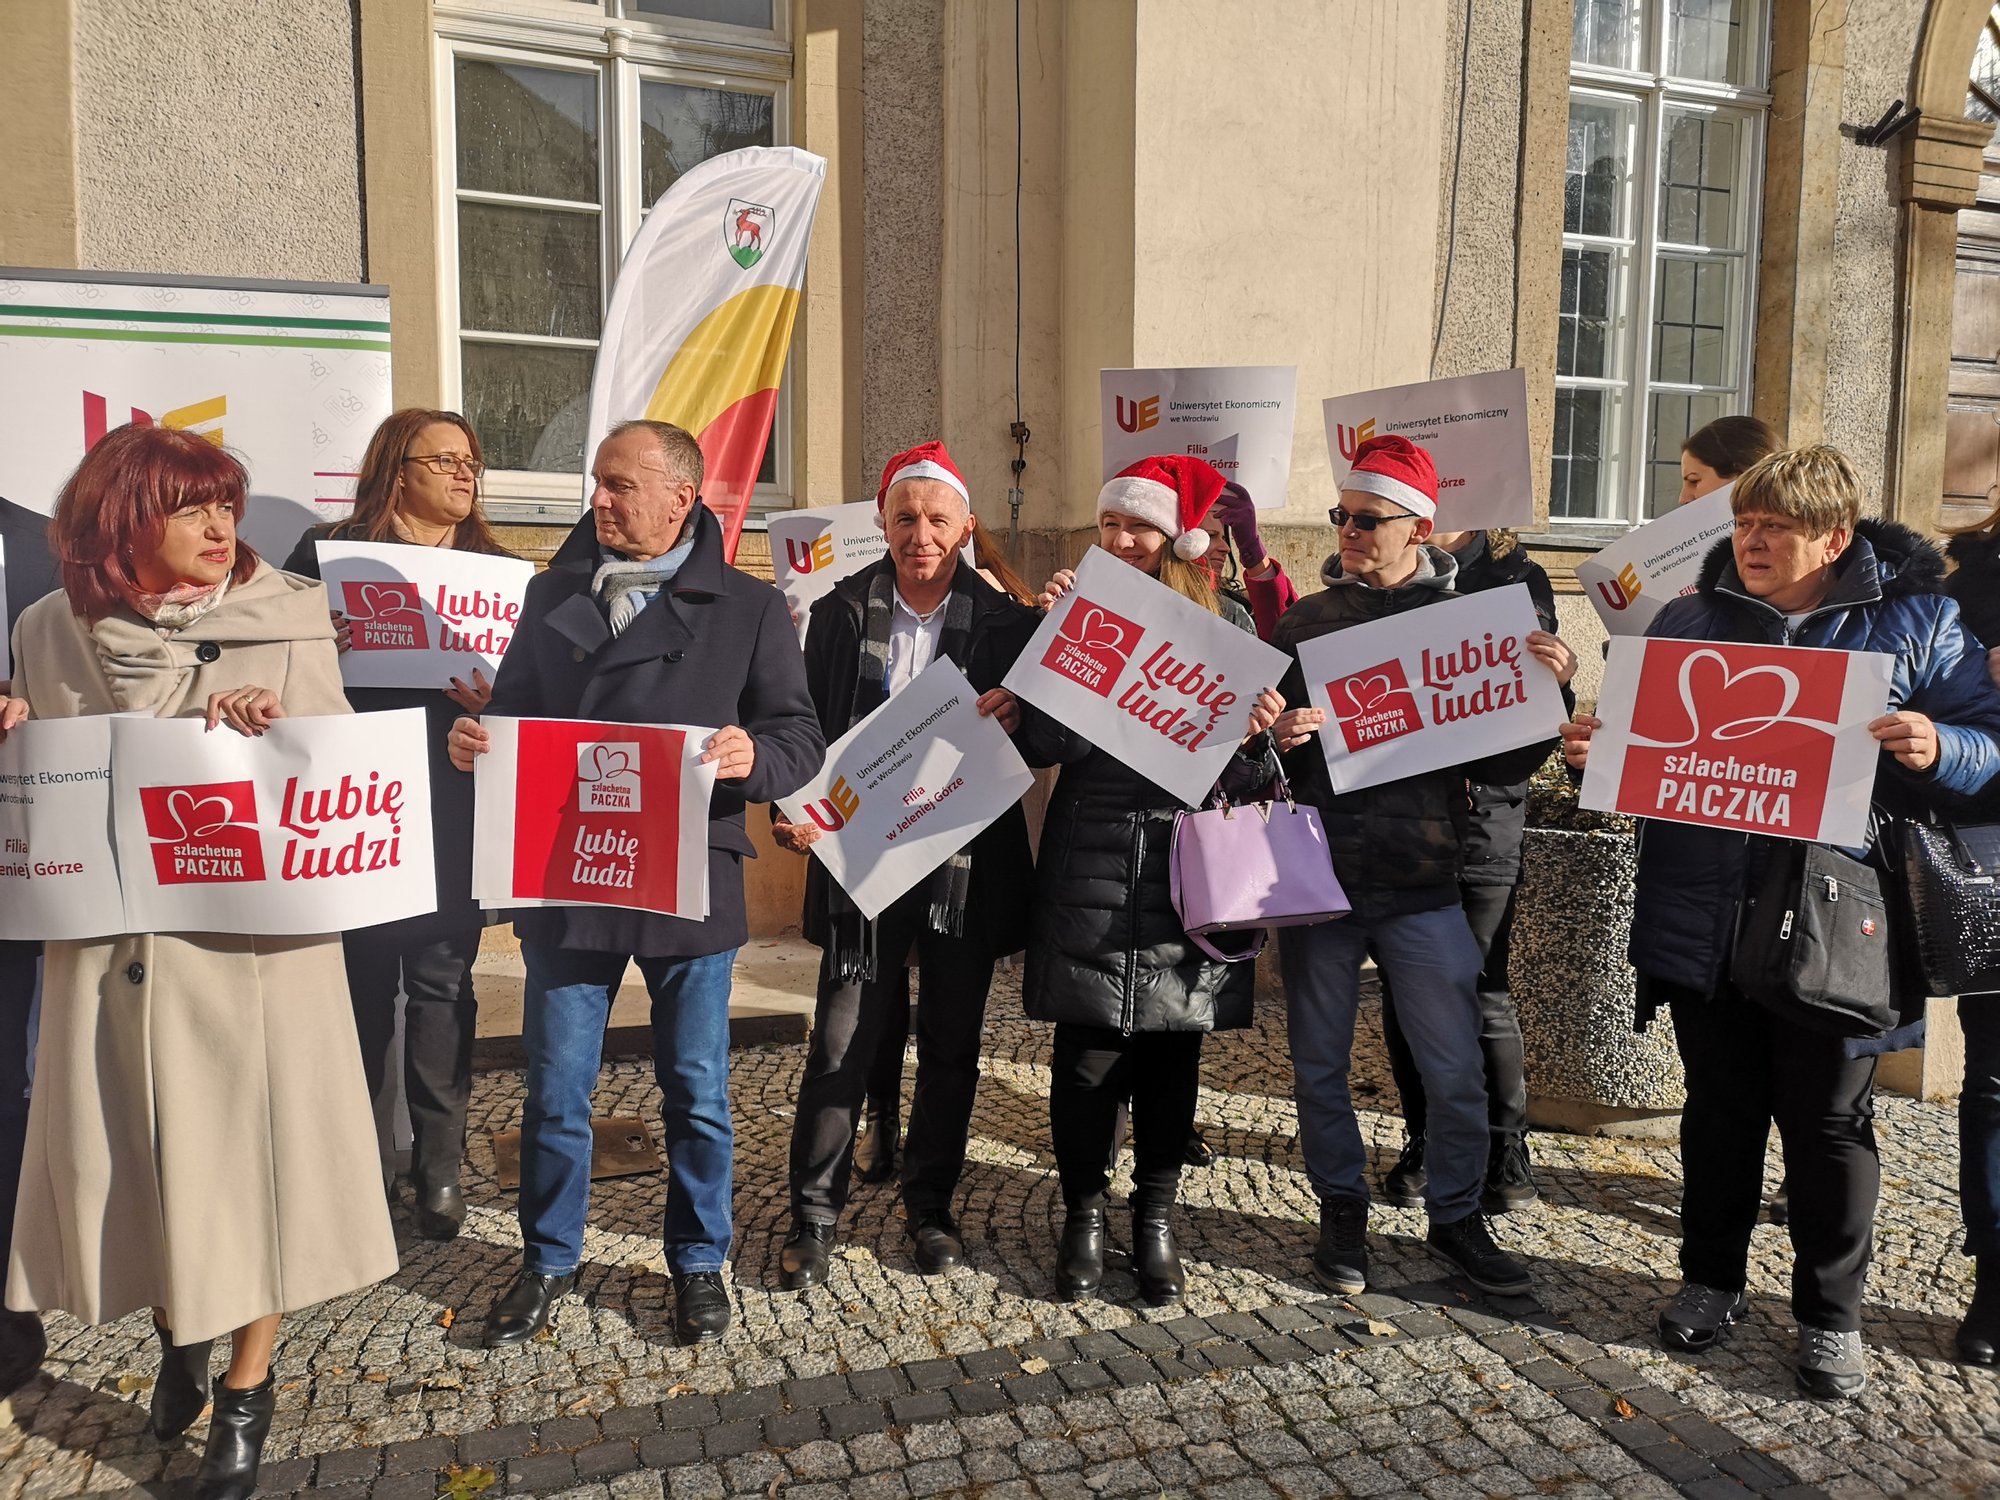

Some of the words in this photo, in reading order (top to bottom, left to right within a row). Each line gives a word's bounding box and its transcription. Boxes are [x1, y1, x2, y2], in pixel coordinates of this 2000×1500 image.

[1116, 394, 1160, 433] UE
[1169, 401, 1222, 411] Uniwersytet
[1225, 399, 1281, 409] Ekonomiczny
[1182, 414, 1219, 423] Wrocławiu
[1386, 417, 1441, 432] Uniwersytet
[1444, 407, 1509, 424] Ekonomiczny
[1187, 444, 1208, 454] Filia
[1209, 459, 1240, 469] Górze
[785, 533, 834, 574] UE
[843, 534, 884, 546] Uniwersy
[858, 547, 888, 556] Wrocław
[1643, 536, 1698, 569] Uniwersytet
[1698, 519, 1736, 541] Ekonom
[1650, 570, 1661, 580] we
[1661, 550, 1699, 573] Wrocławiu
[1597, 562, 1642, 611] UE
[436, 585, 519, 629] Lubię
[364, 620, 413, 633] szlachetna
[365, 632, 415, 646] PACZKA
[439, 623, 510, 655] ludz
[1055, 652, 1102, 688] PACZKA
[1064, 643, 1108, 674] szlachetna
[1421, 632, 1521, 691] Lubię
[1139, 641, 1237, 723] Lubię
[1432, 670, 1528, 726] ludzi
[1116, 681, 1214, 753] ludzi
[1354, 708, 1404, 728] szlachetna
[1356, 717, 1408, 742] PACZKA
[857, 738, 907, 780] Uniwersytet
[905, 695, 960, 741] Ekonomiczny
[39, 767, 112, 784] Ekonomic
[867, 778, 883, 790] we
[882, 752, 913, 781] Wrocławiu
[1663, 751, 1797, 788] szlachetna
[591, 783, 631, 795] szlachetna
[591, 794, 631, 808] PACZKA
[802, 774, 861, 832] UE
[902, 785, 926, 806] Filia
[1655, 778, 1791, 827] PACZKA
[279, 771, 404, 839] Lubię
[886, 829, 897, 841] w
[896, 800, 936, 834] Jeleniej
[934, 776, 964, 804] Górze
[5, 838, 28, 853] Filia
[173, 845, 242, 859] szlachetna
[281, 825, 401, 881] ludzi
[573, 825, 639, 864] Lubię
[0, 862, 31, 879] eniej
[34, 861, 84, 876] Górze
[174, 858, 244, 877] PACZKA
[572, 859, 636, 889] ludzi
